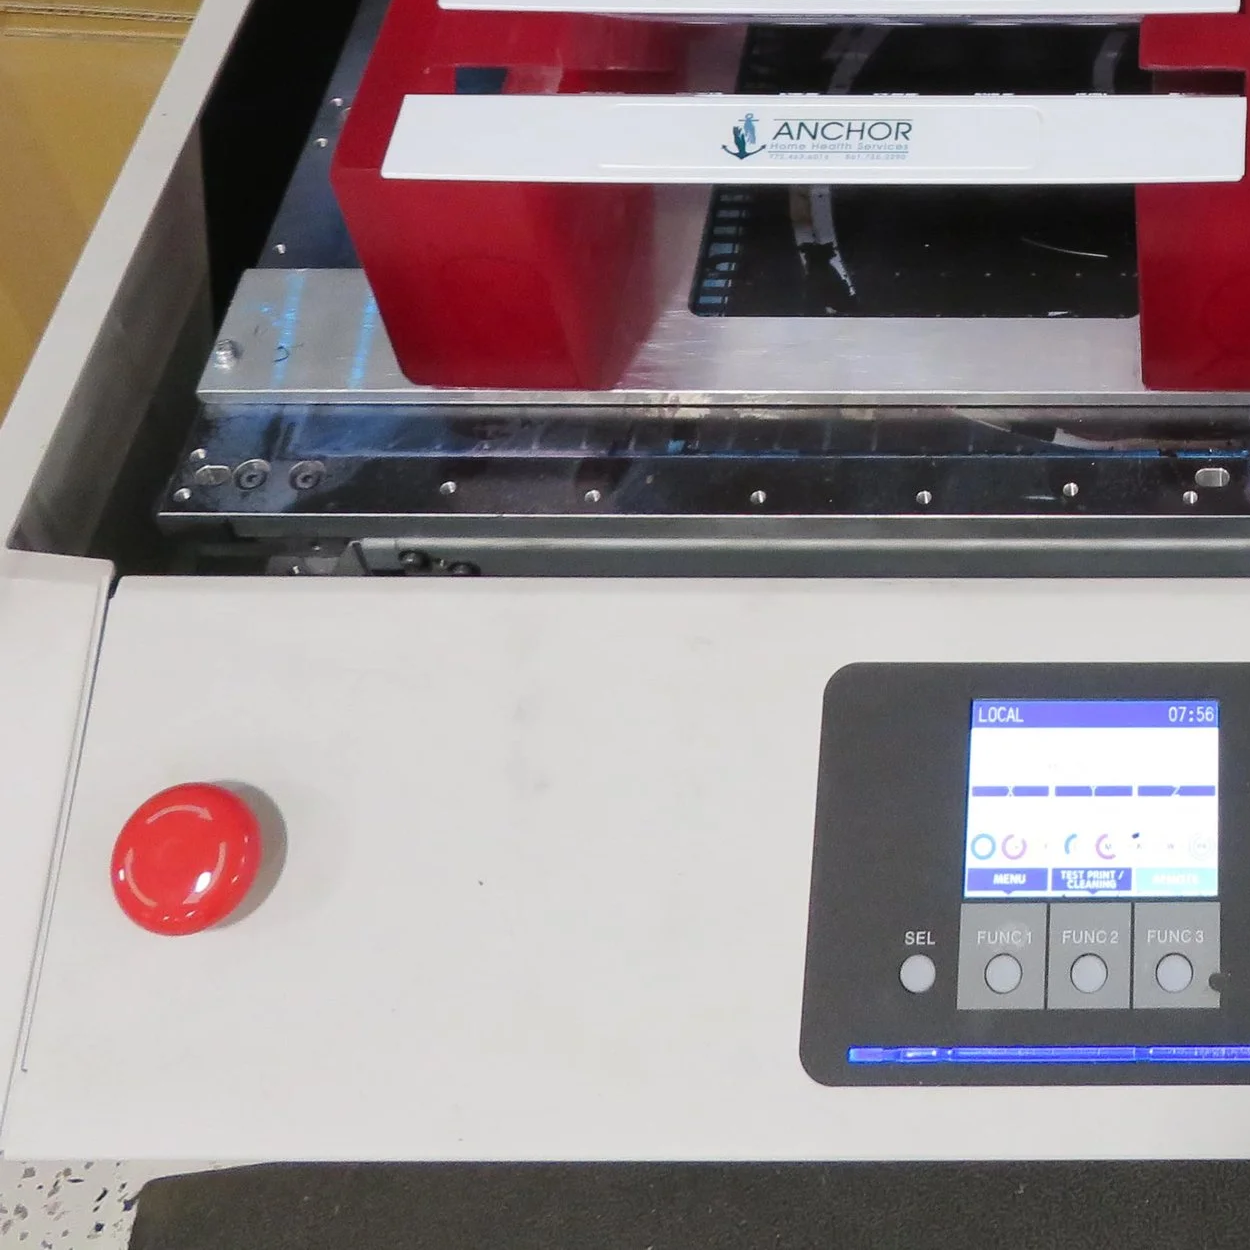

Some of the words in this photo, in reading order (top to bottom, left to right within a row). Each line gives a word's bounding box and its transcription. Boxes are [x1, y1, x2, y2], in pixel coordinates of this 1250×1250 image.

[772, 121, 913, 141] ANCHOR
[770, 142, 806, 151] Home
[811, 141, 850, 151] Health
[857, 142, 909, 151] Services
[978, 706, 1024, 723] LOCAL
[1168, 706, 1215, 723] 07:56
[993, 874, 1026, 885] MENU
[1061, 870, 1085, 880] TEST
[1087, 870, 1116, 880] PRINT
[1067, 879, 1117, 889] CLEANING
[904, 931, 936, 946] SEL
